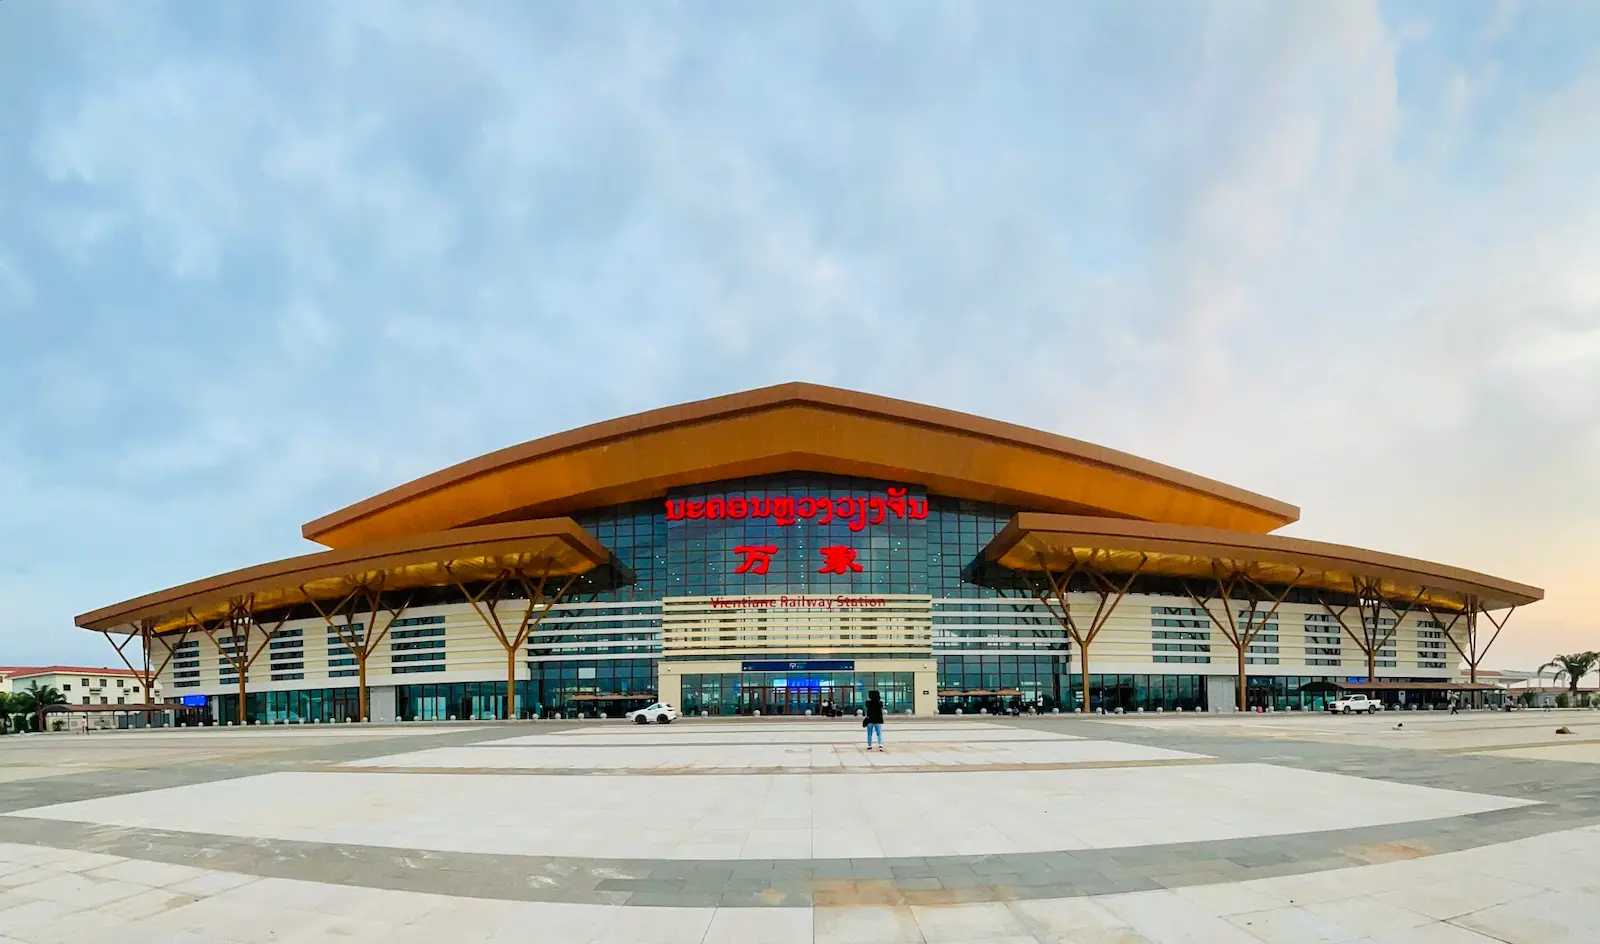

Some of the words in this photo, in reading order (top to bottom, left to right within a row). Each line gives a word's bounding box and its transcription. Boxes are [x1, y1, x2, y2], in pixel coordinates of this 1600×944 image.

[710, 596, 777, 609] Vientiane
[780, 595, 833, 609] Railway
[837, 595, 886, 608] Station
